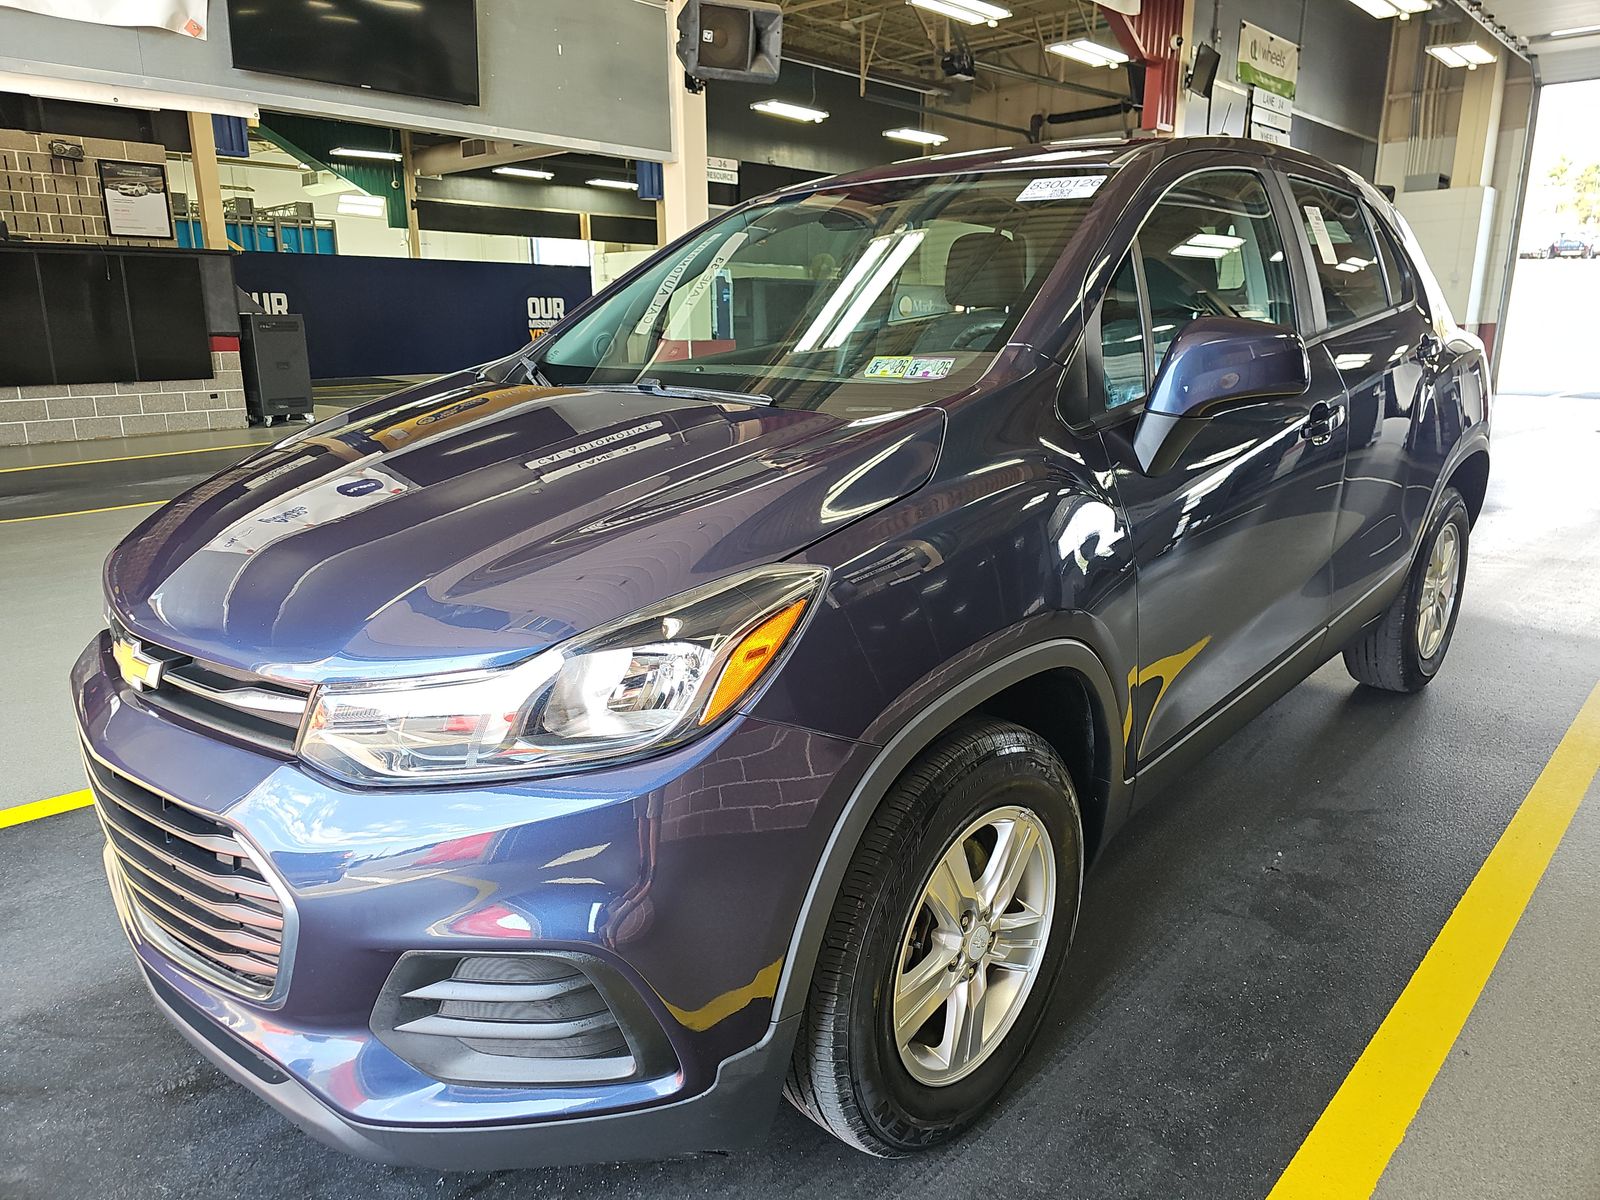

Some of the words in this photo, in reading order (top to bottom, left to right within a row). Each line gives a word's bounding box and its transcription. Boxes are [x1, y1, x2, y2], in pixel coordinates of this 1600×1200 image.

[1261, 44, 1285, 68] wheels
[1262, 93, 1275, 107] LANE
[1030, 178, 1103, 190] 8300126
[246, 292, 288, 315] UR
[527, 297, 565, 318] OUR
[893, 359, 909, 374] 26
[935, 361, 951, 376] 26
